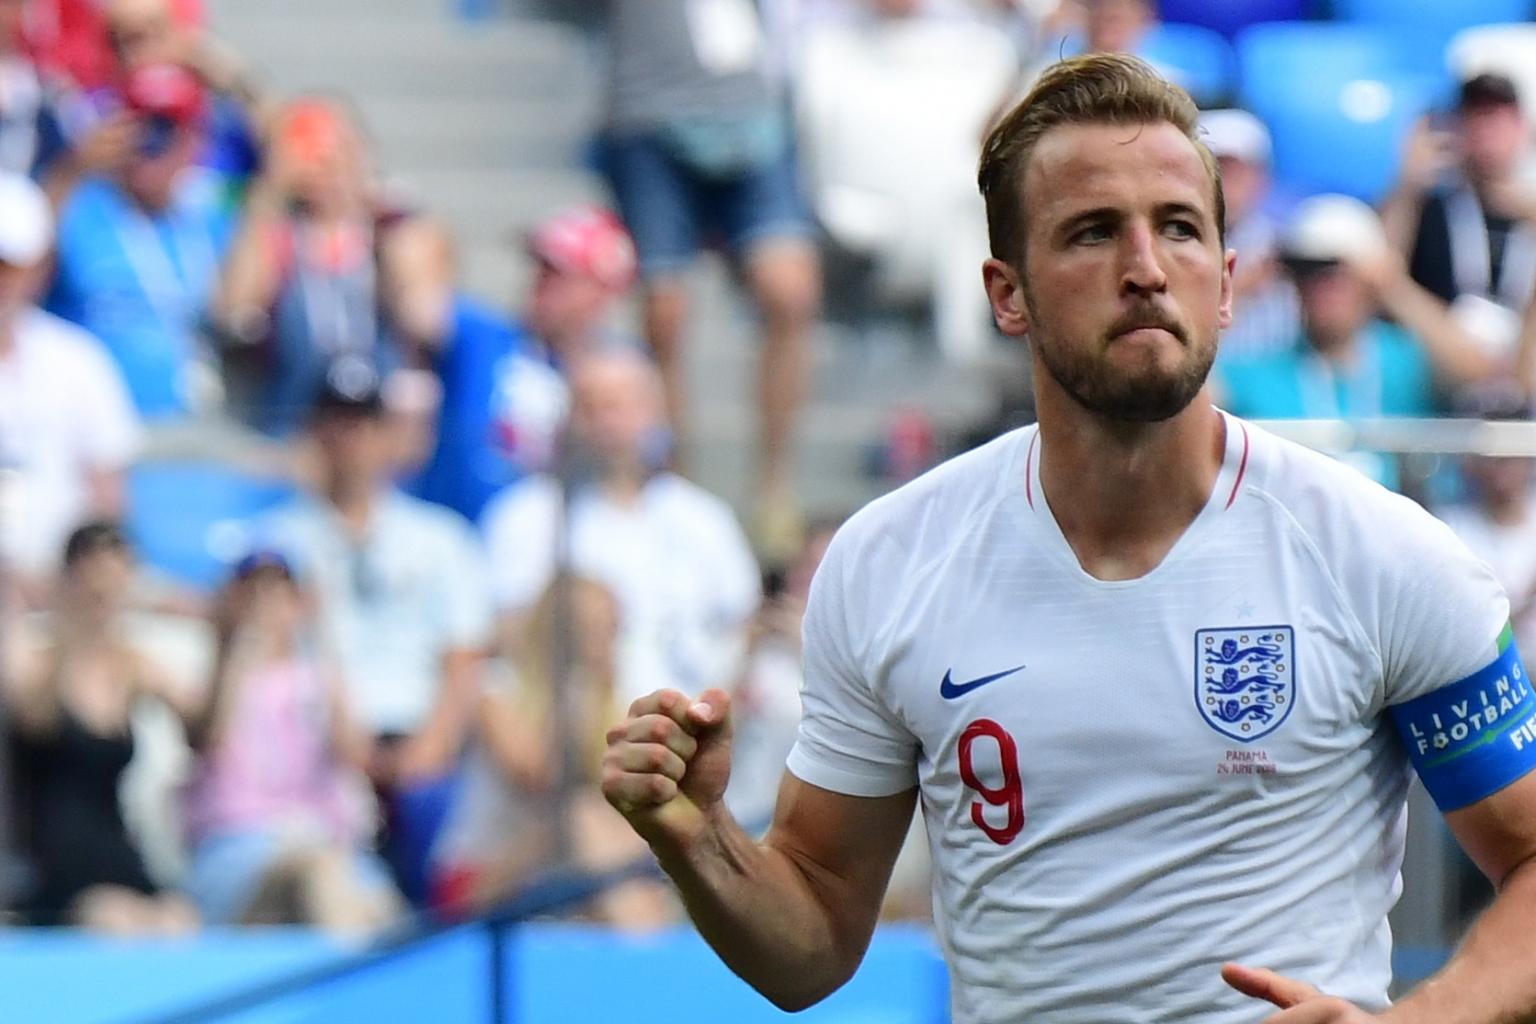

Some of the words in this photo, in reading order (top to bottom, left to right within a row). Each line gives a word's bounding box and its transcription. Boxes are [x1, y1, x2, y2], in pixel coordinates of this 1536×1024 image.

[1410, 661, 1522, 738] LIVING
[957, 717, 1025, 846] 9
[1225, 750, 1268, 761] PANAMA
